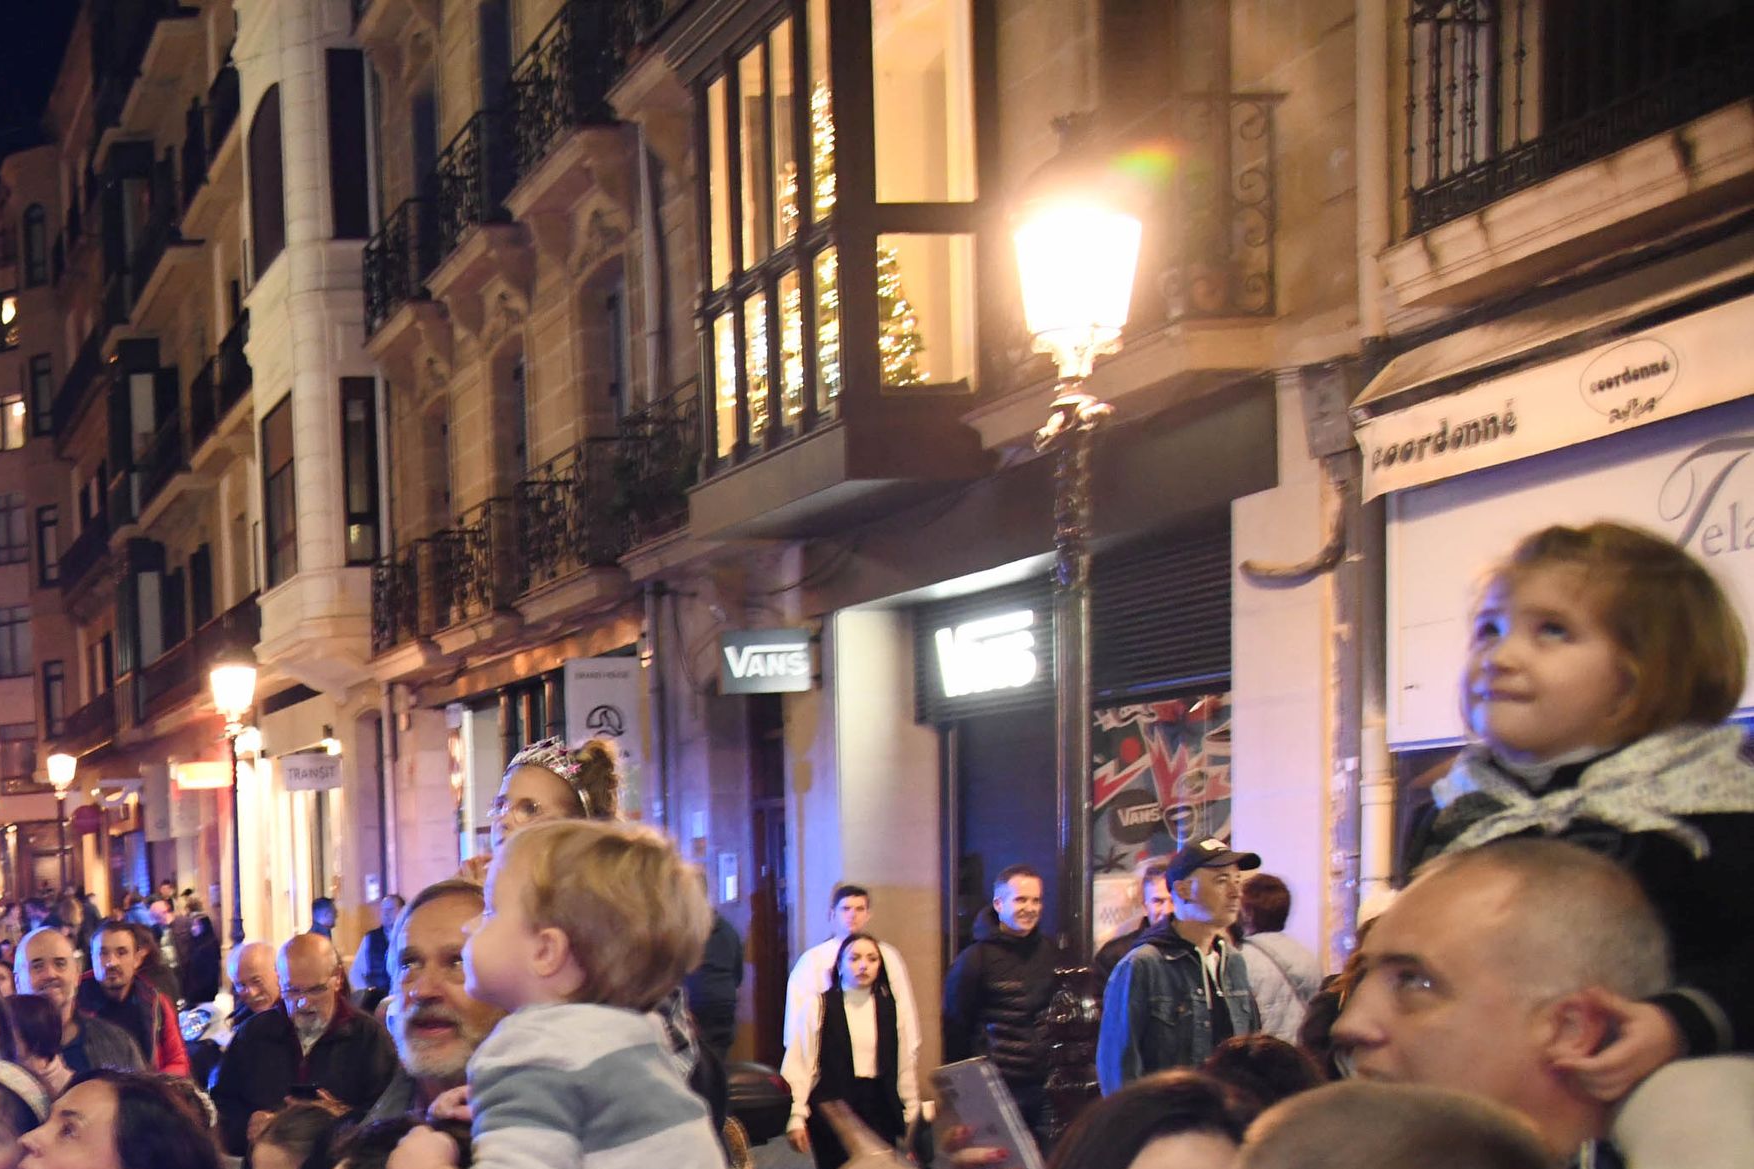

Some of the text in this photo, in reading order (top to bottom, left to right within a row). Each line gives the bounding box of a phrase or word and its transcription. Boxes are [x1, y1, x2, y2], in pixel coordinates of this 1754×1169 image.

[724, 642, 810, 679] VANS
[934, 609, 1037, 698] VS
[1116, 802, 1162, 827] VANS
